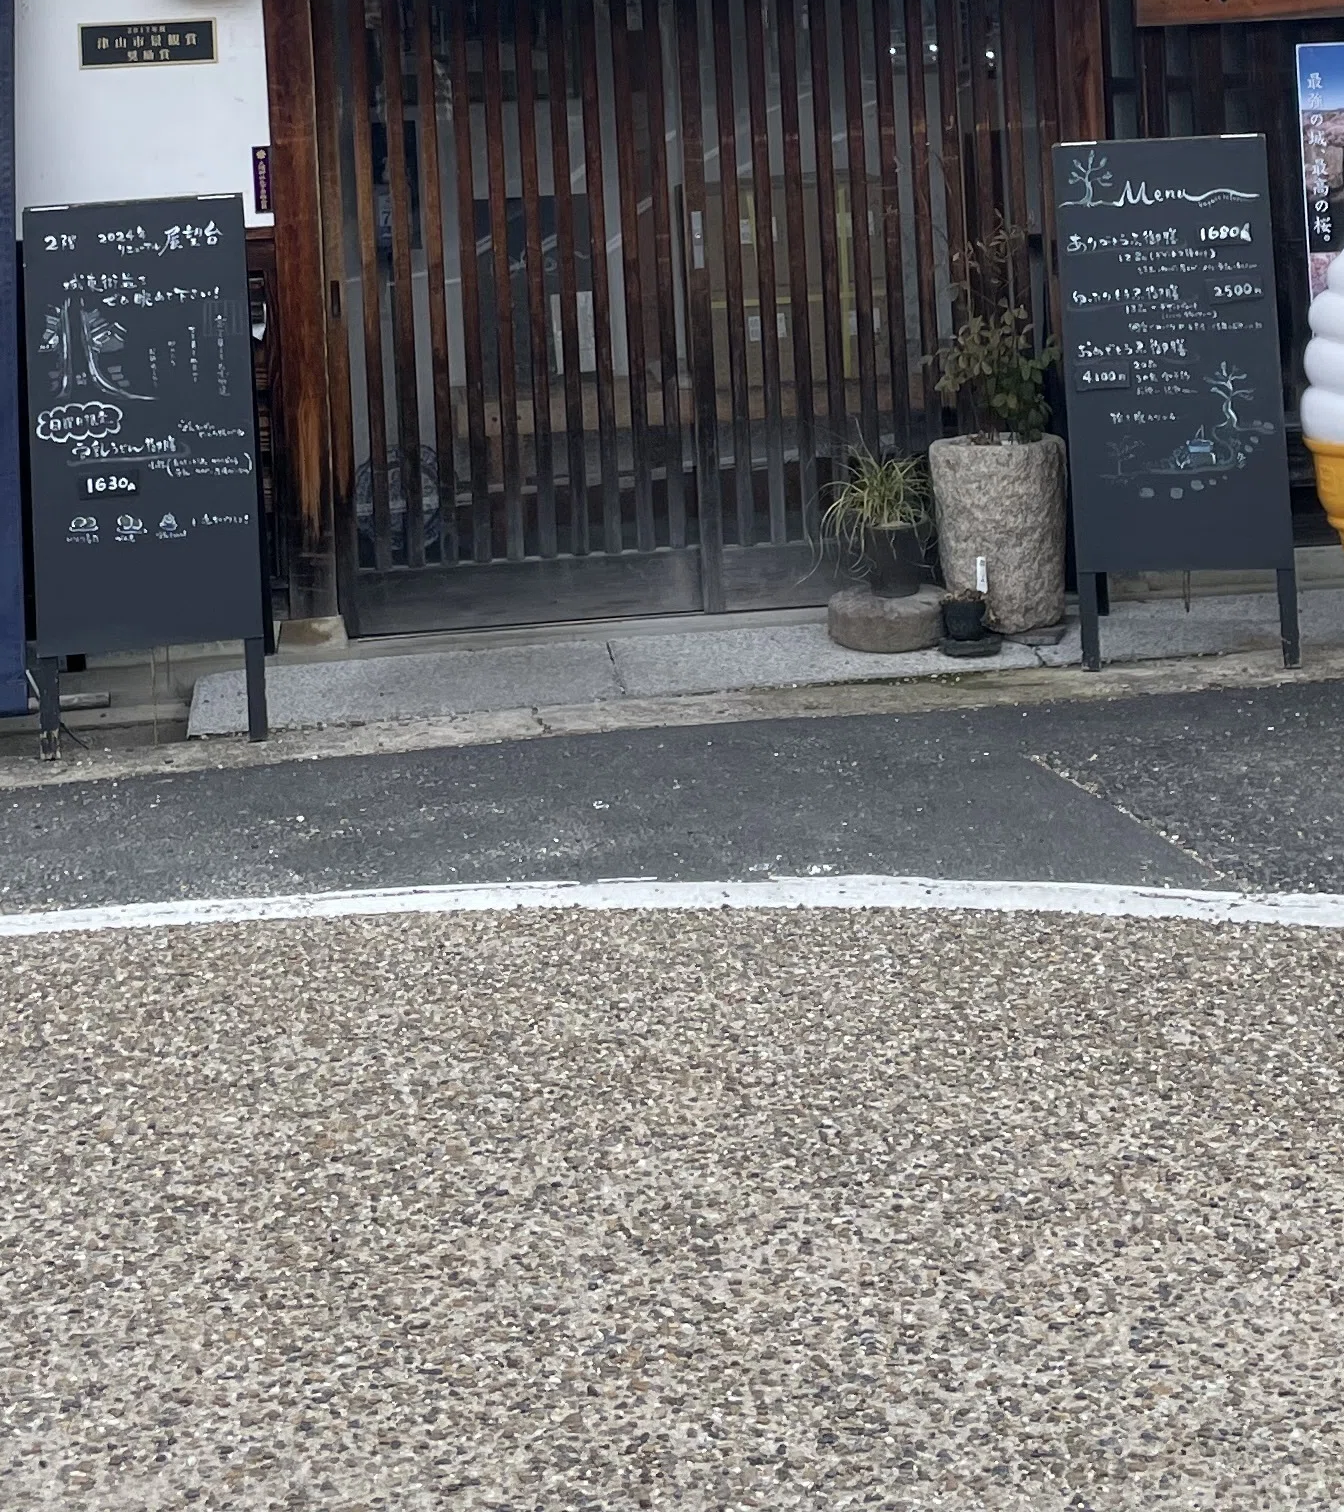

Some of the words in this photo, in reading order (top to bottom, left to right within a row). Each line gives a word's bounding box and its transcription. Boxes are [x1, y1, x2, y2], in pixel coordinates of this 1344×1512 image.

[1114, 180, 1188, 206] Menu
[158, 220, 223, 257] 展望台
